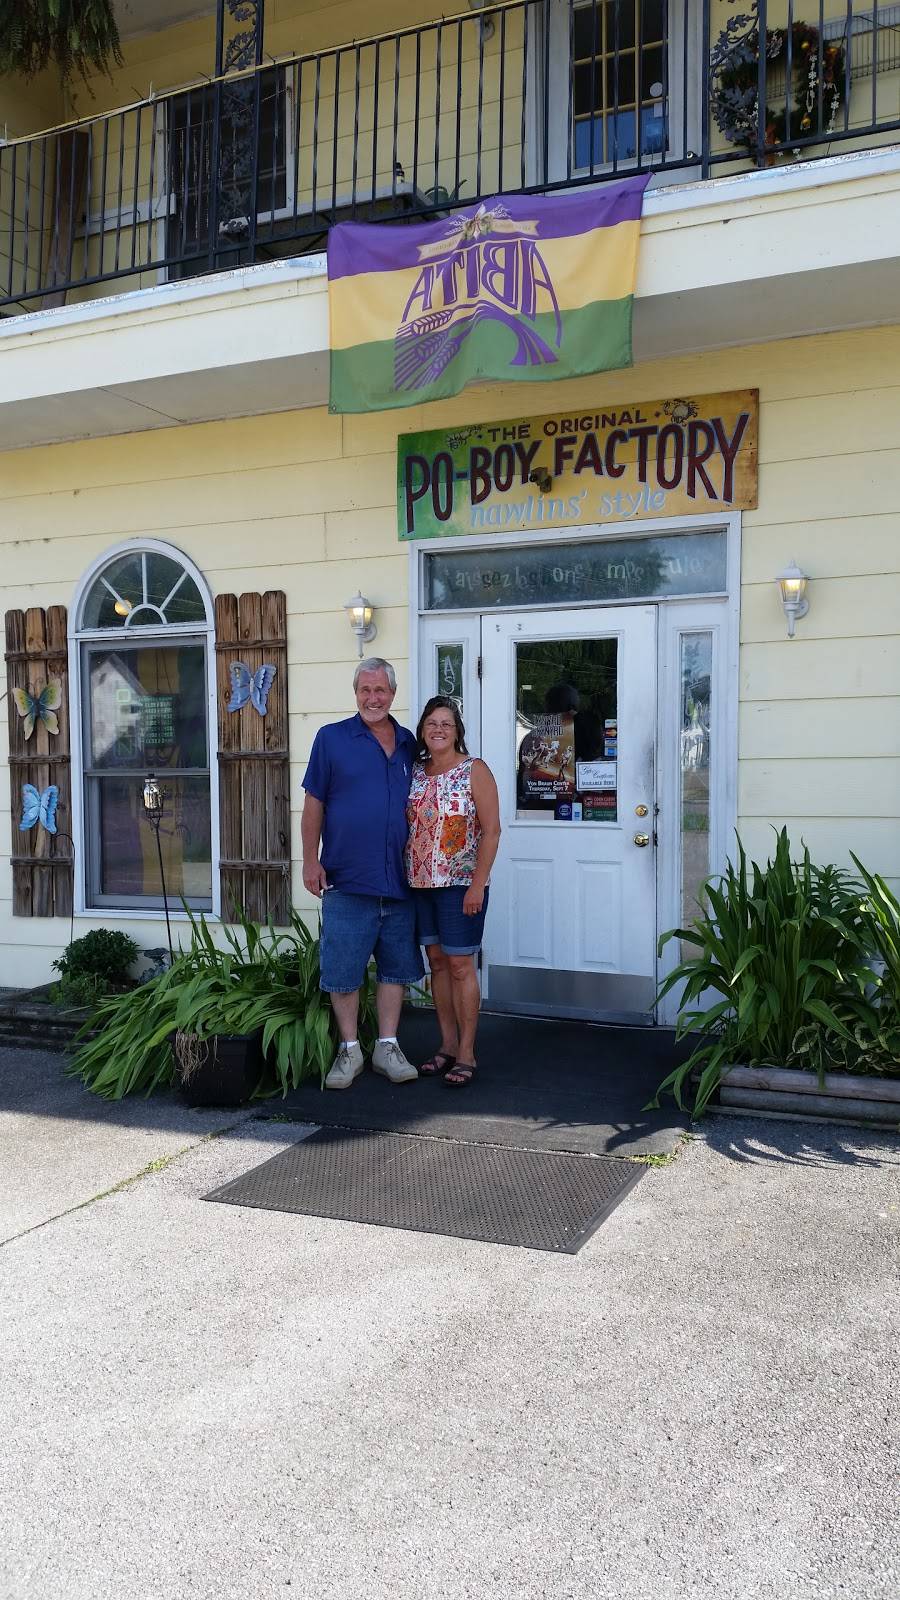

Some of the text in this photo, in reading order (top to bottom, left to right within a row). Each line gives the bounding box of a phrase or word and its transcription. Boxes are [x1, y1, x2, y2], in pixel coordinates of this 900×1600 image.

[488, 409, 648, 442] THE ORIGINAL
[405, 413, 750, 534] PO-BOY FACTORY
[599, 485, 666, 519] style
